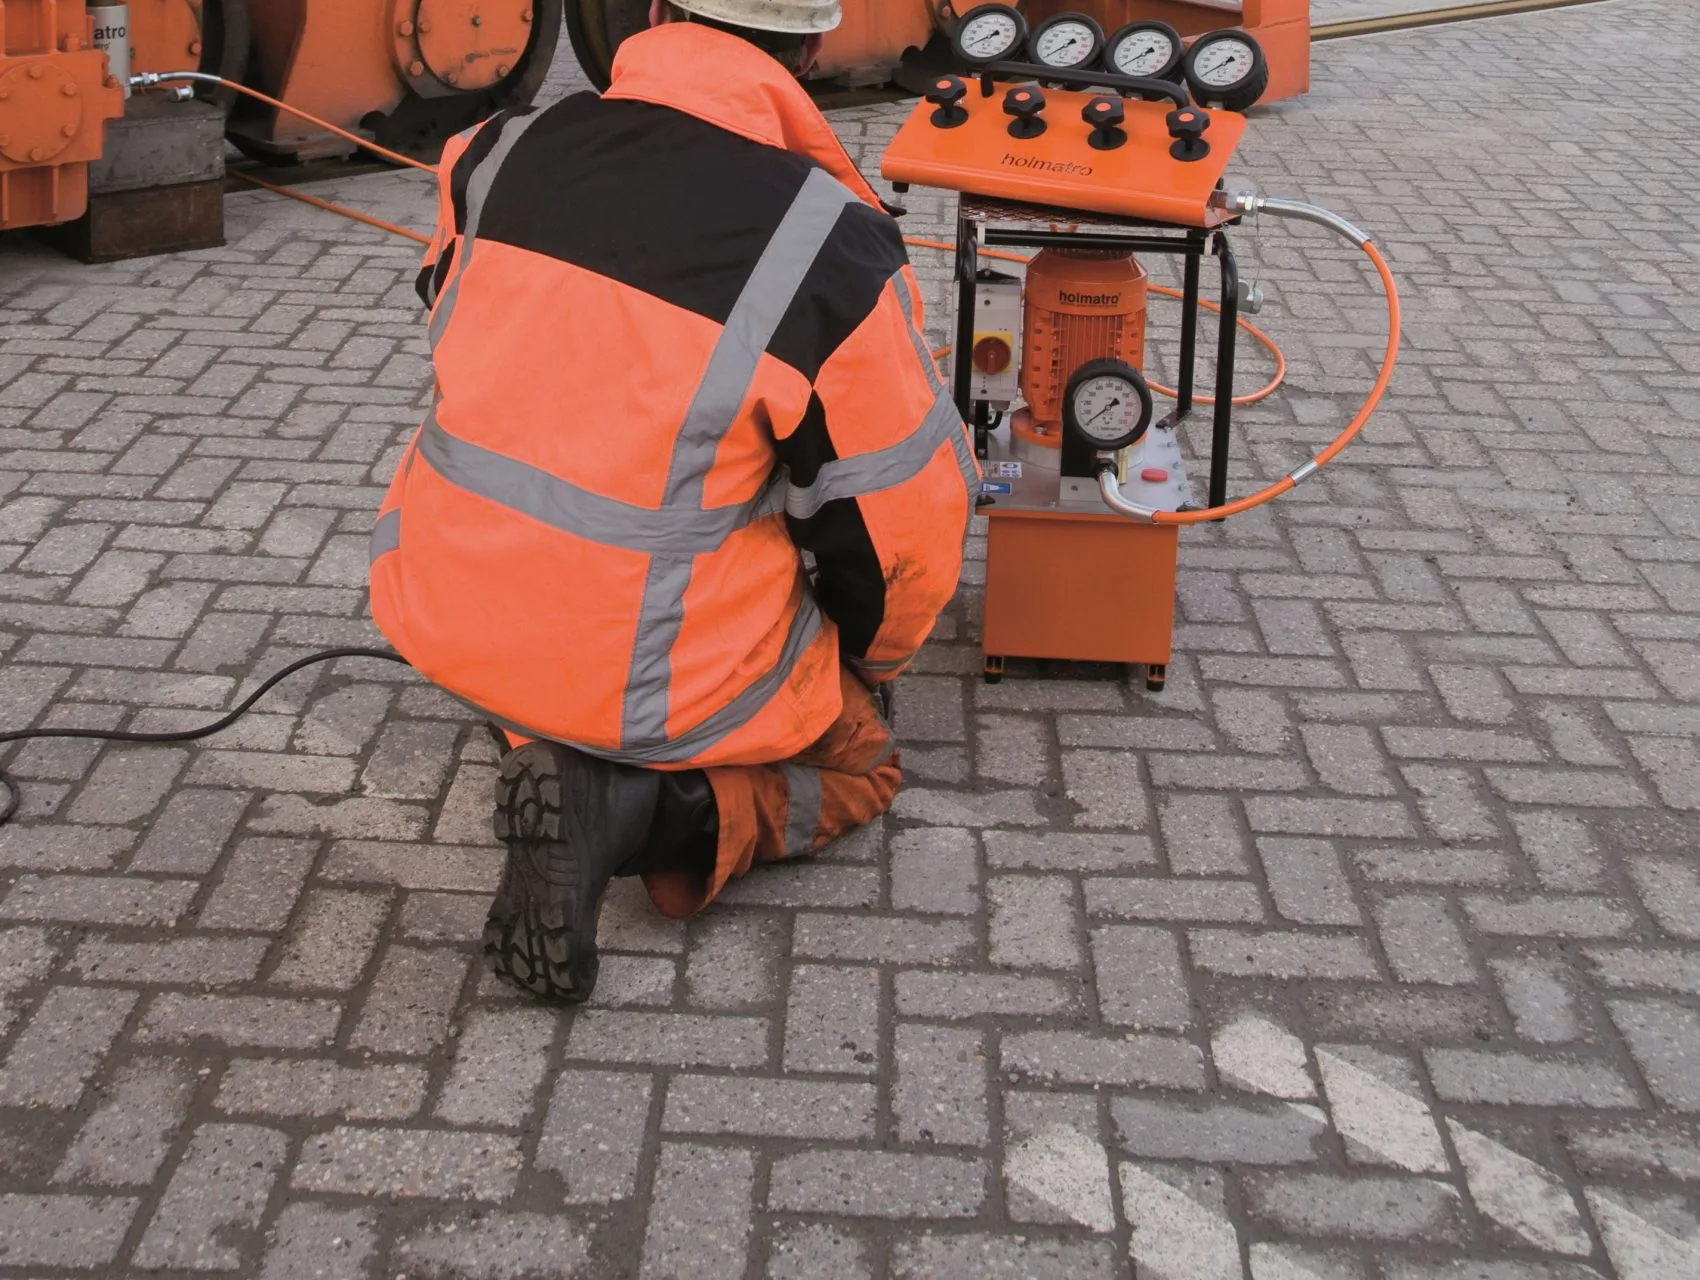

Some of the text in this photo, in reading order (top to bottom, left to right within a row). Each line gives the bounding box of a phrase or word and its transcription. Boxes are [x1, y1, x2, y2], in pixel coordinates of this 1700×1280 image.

[94, 25, 126, 40] atro
[1001, 153, 1093, 176] holmatro
[1059, 290, 1119, 305] holmatro
